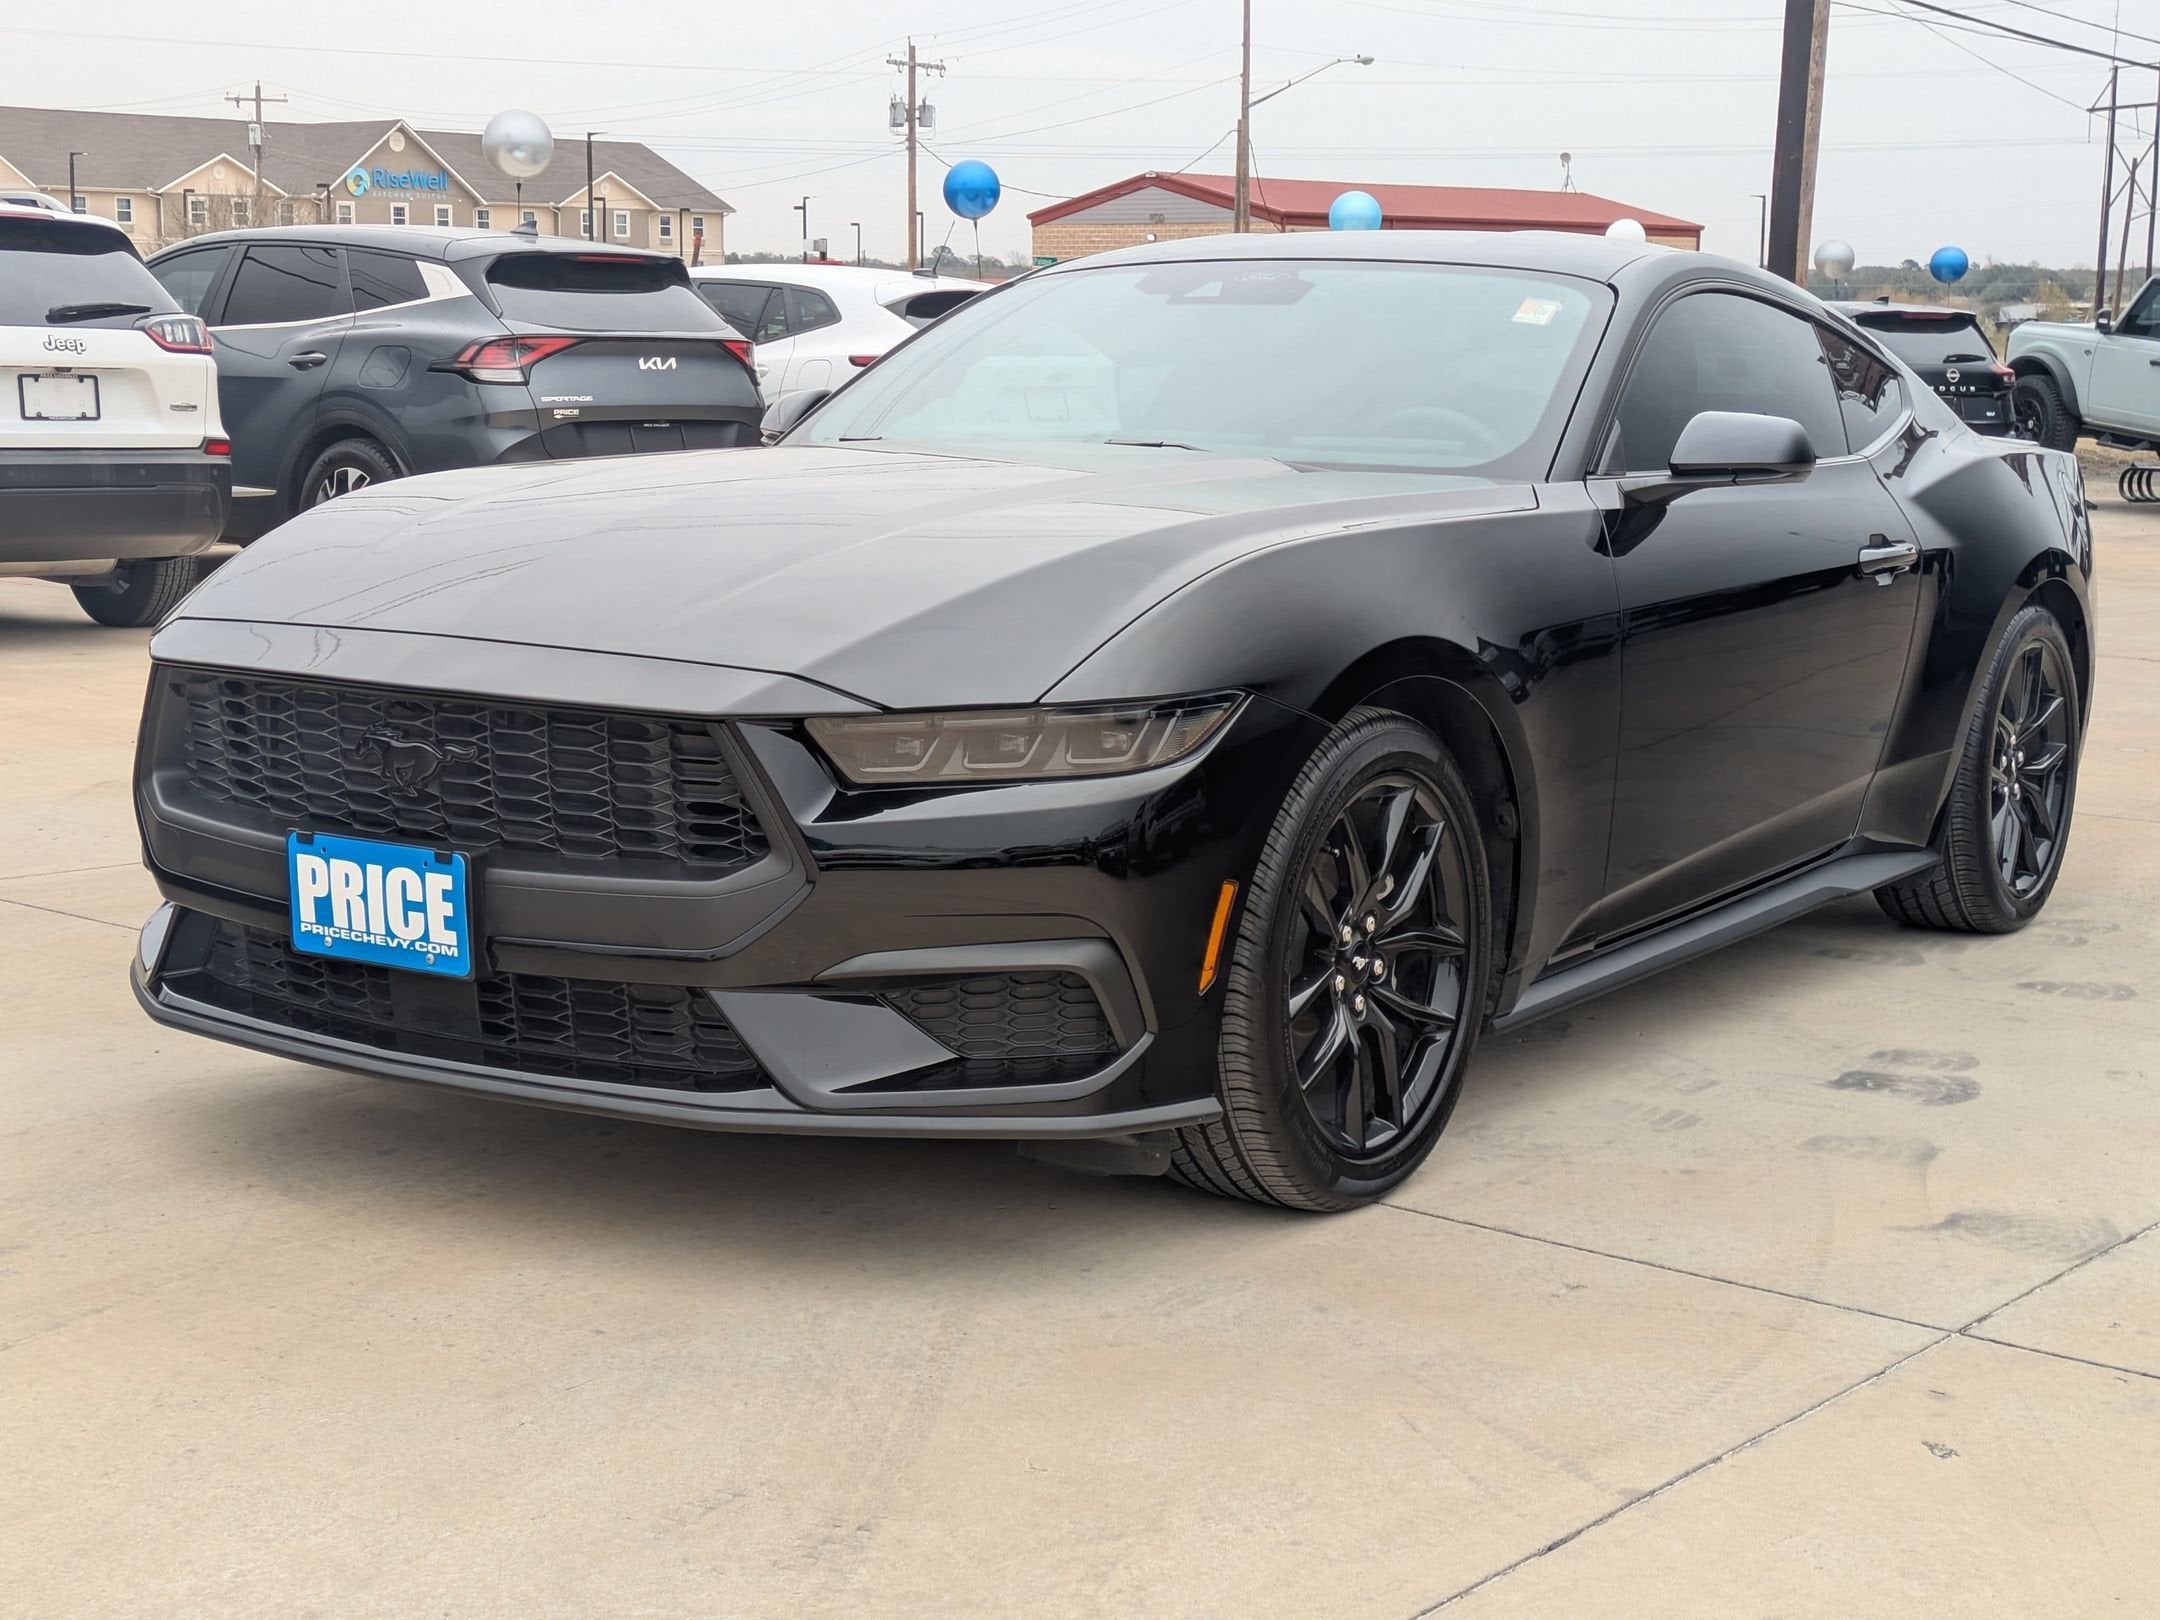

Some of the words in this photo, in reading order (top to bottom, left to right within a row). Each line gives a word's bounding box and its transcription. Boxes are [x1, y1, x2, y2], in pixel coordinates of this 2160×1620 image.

[372, 168, 448, 190] RiseWell
[43, 335, 87, 354] Jeep
[638, 357, 677, 370] KIA
[296, 853, 458, 946] PRICE
[300, 922, 459, 957] PRICECHEVY.COM
